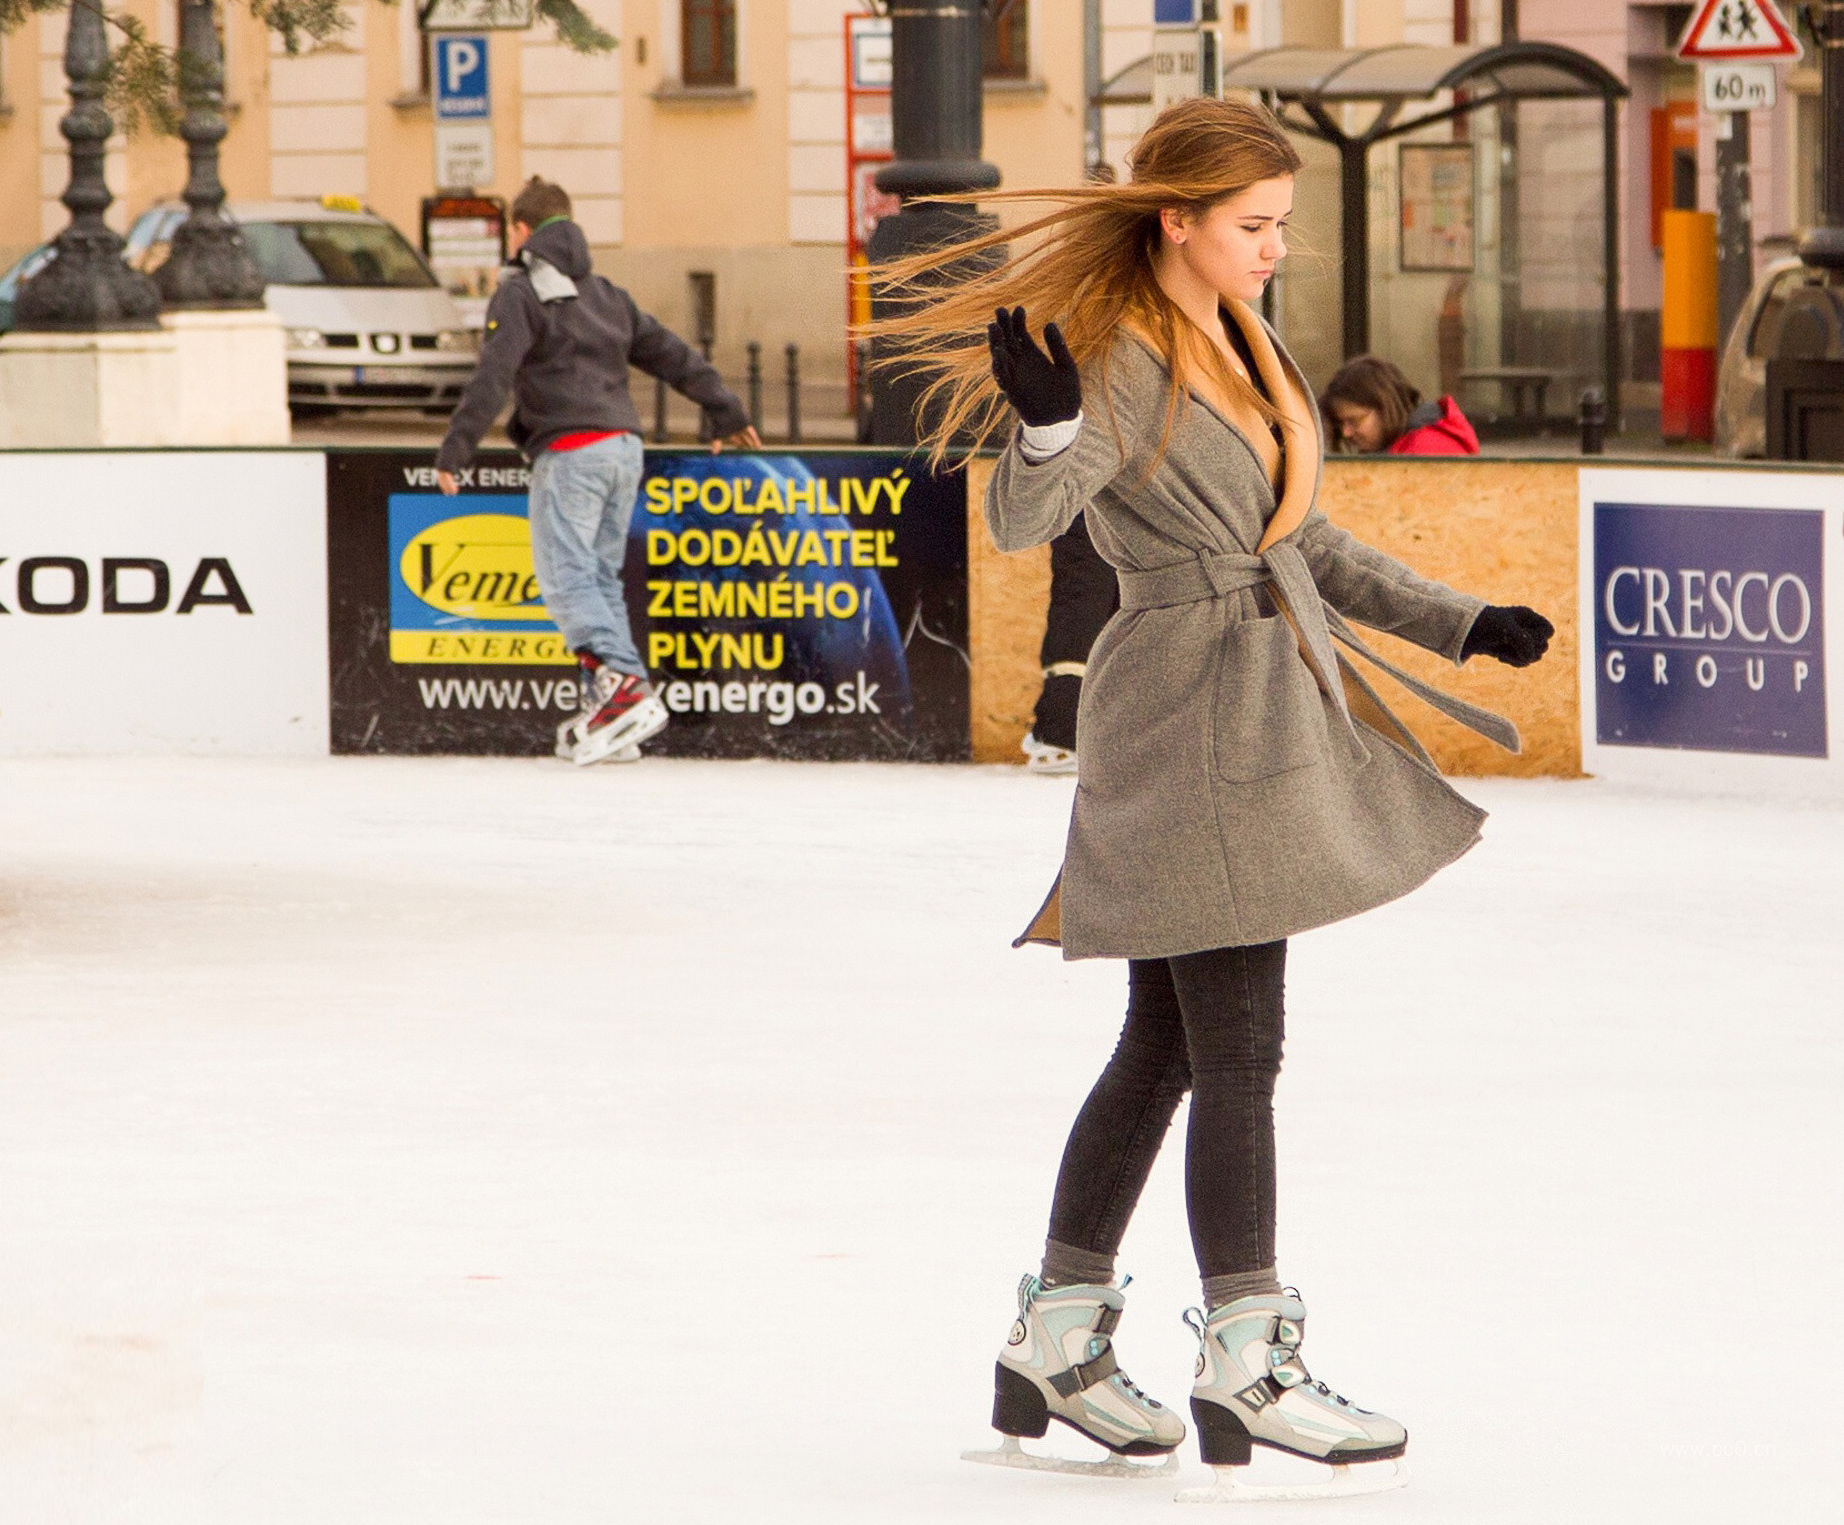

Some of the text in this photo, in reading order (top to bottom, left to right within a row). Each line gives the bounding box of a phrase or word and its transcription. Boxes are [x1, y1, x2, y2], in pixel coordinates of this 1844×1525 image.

[447, 41, 479, 93] P
[1715, 74, 1766, 100] 60 m
[403, 468, 534, 487] VEX ENER
[645, 468, 911, 515] SPOĽAHLIVÝ
[647, 519, 898, 567] DODÁVATEĽ
[418, 544, 542, 607] Veme
[646, 572, 859, 619] ZEMNÉHO
[1604, 566, 1811, 644] CRESCO
[427, 638, 576, 659] ENERG
[648, 632, 785, 670] PLYNU
[1606, 651, 1809, 692] GROUP
